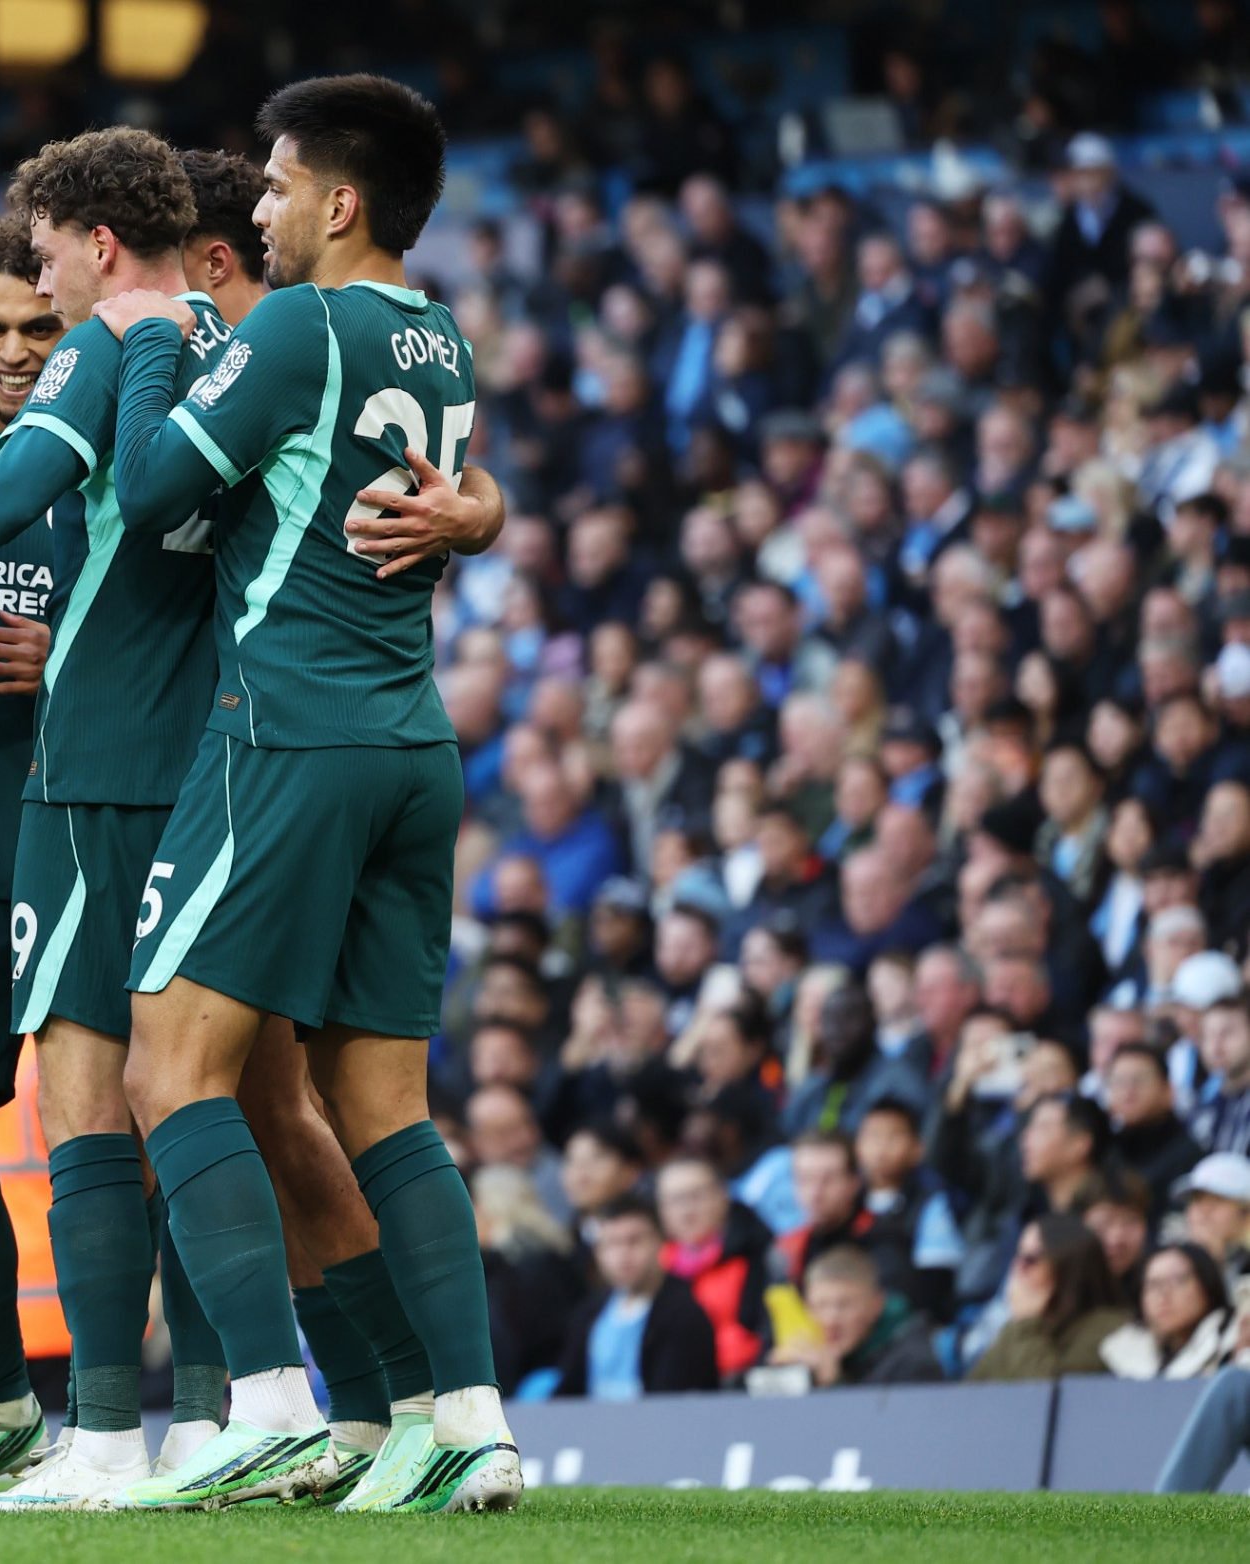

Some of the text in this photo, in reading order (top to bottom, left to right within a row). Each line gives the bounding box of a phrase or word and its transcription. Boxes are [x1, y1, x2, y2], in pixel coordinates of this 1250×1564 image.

[391, 327, 460, 378] GOMEZ
[136, 861, 176, 939] 5
[11, 901, 38, 980] 9
